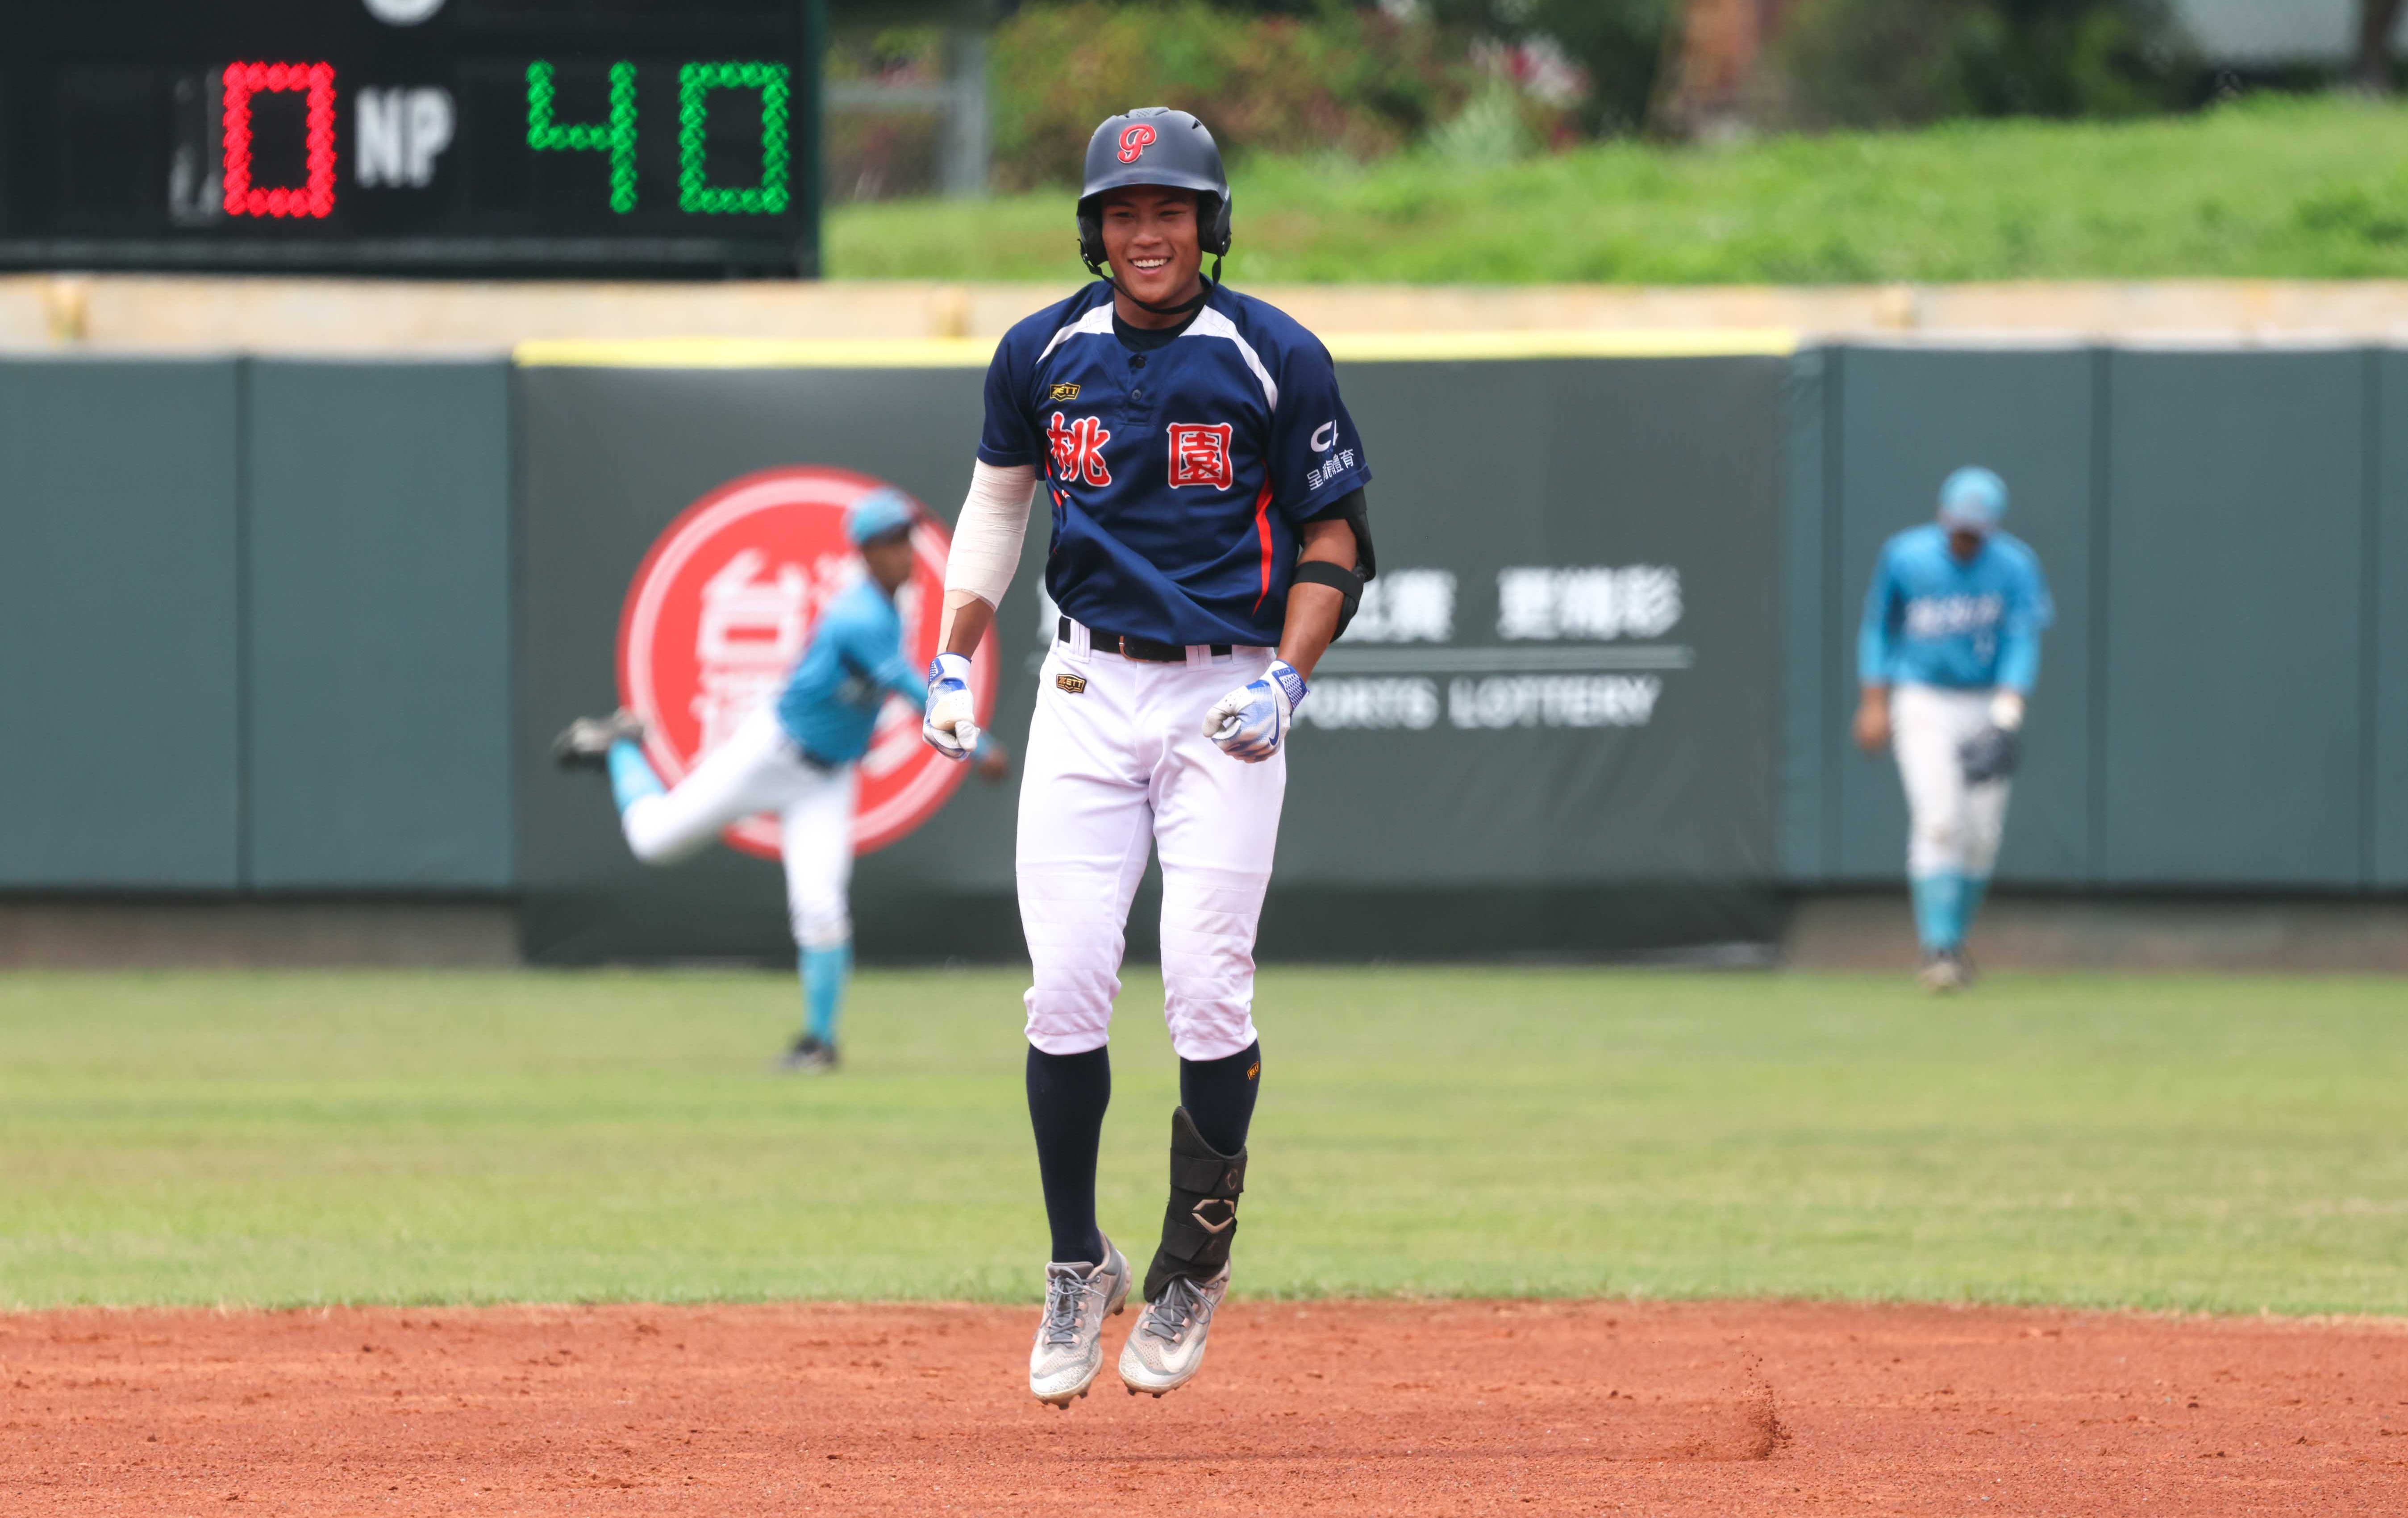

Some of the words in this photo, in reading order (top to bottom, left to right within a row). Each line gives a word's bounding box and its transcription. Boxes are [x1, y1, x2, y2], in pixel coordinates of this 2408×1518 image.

[223, 60, 336, 218] 0
[355, 85, 456, 188] NP
[1117, 124, 1157, 163] P
[1448, 674, 1662, 729] LOTTERY
